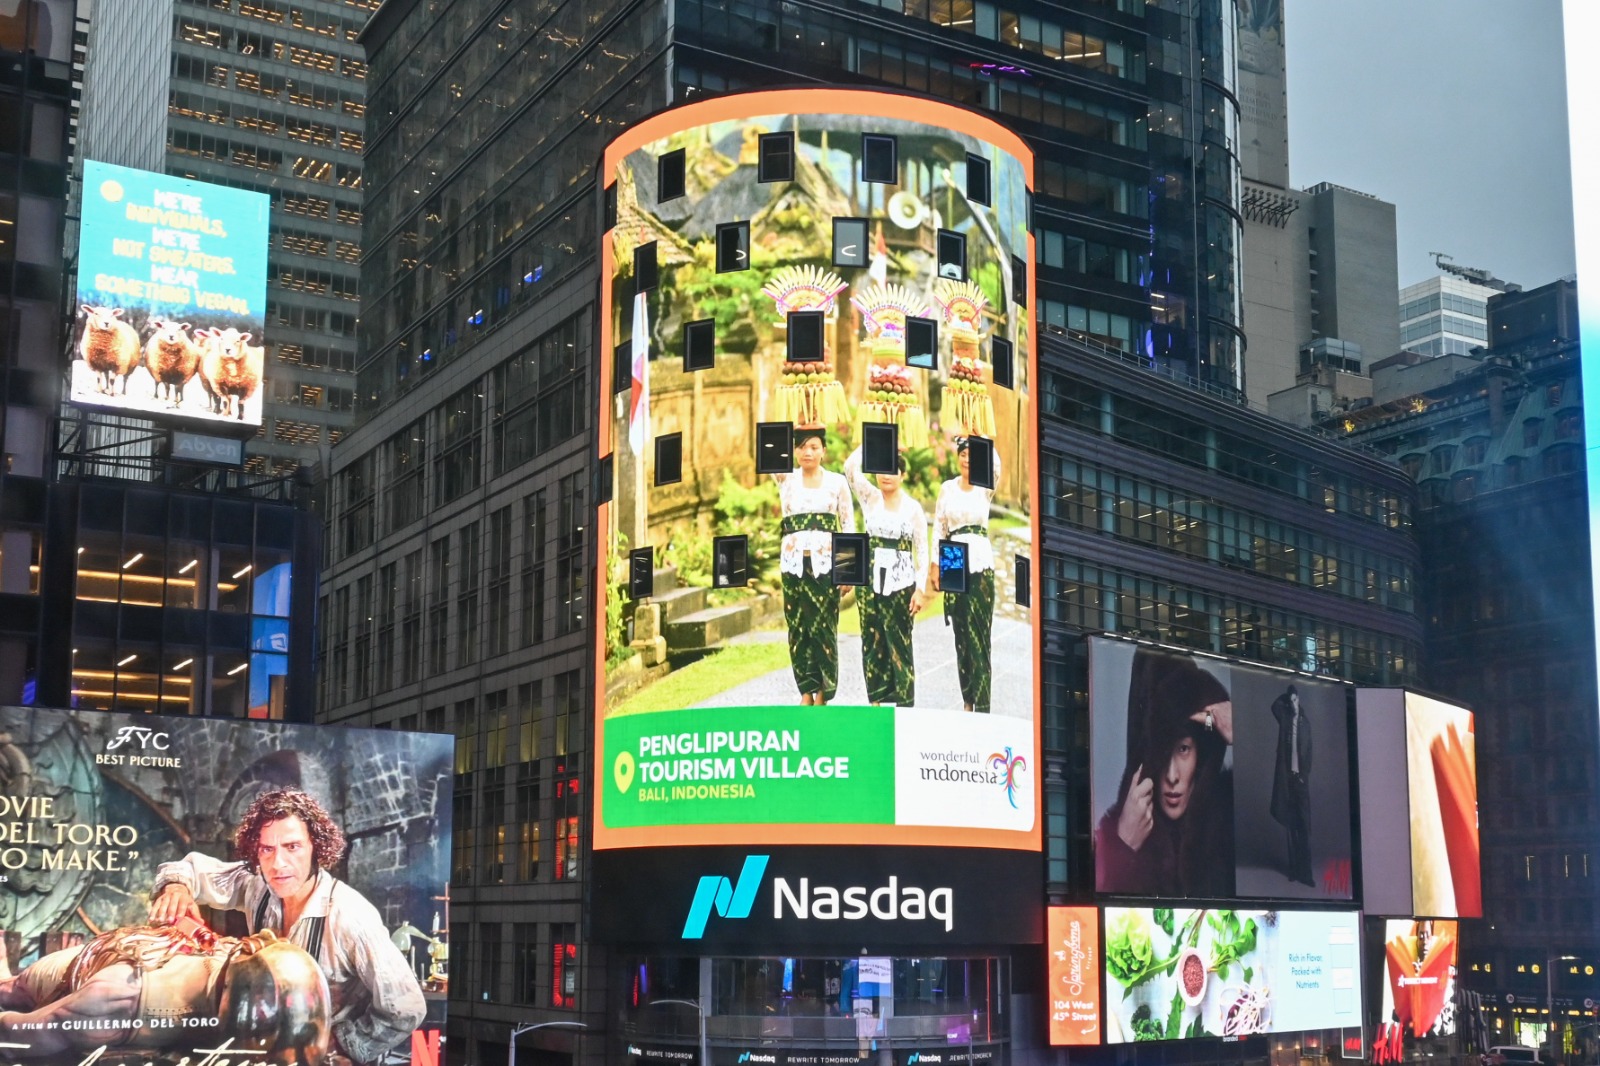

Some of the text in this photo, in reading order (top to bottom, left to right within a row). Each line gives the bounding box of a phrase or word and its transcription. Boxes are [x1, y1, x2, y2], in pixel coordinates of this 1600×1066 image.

[113, 238, 146, 259] NOT
[151, 264, 199, 289] WEAR
[95, 274, 190, 304] SOMETHING
[179, 436, 237, 459] Absen
[107, 726, 170, 750] FYC
[639, 730, 800, 757] PENGLIPURAN
[96, 754, 182, 768] BEST PICTURE
[920, 751, 980, 764] wonderful
[639, 757, 849, 783] TOURISM VILLAGE
[920, 763, 998, 784] indonesia
[638, 784, 755, 803] BALI, INDONESIA
[53, 824, 138, 846] TORO
[773, 875, 954, 932] Nasdaq
[1289, 953, 1299, 962] Rich
[1291, 966, 1321, 976] Packed with
[1296, 980, 1320, 989] Nutrients
[1054, 1001, 1094, 1010] 104 West
[62, 1019, 143, 1030] GUILLERMO
[150, 1018, 175, 1028] DEL
[181, 1017, 219, 1028] TORO
[1072, 1012, 1097, 1021] Street
[749, 1054, 776, 1063] Nasdaq
[918, 1054, 942, 1063] Nasdaq
